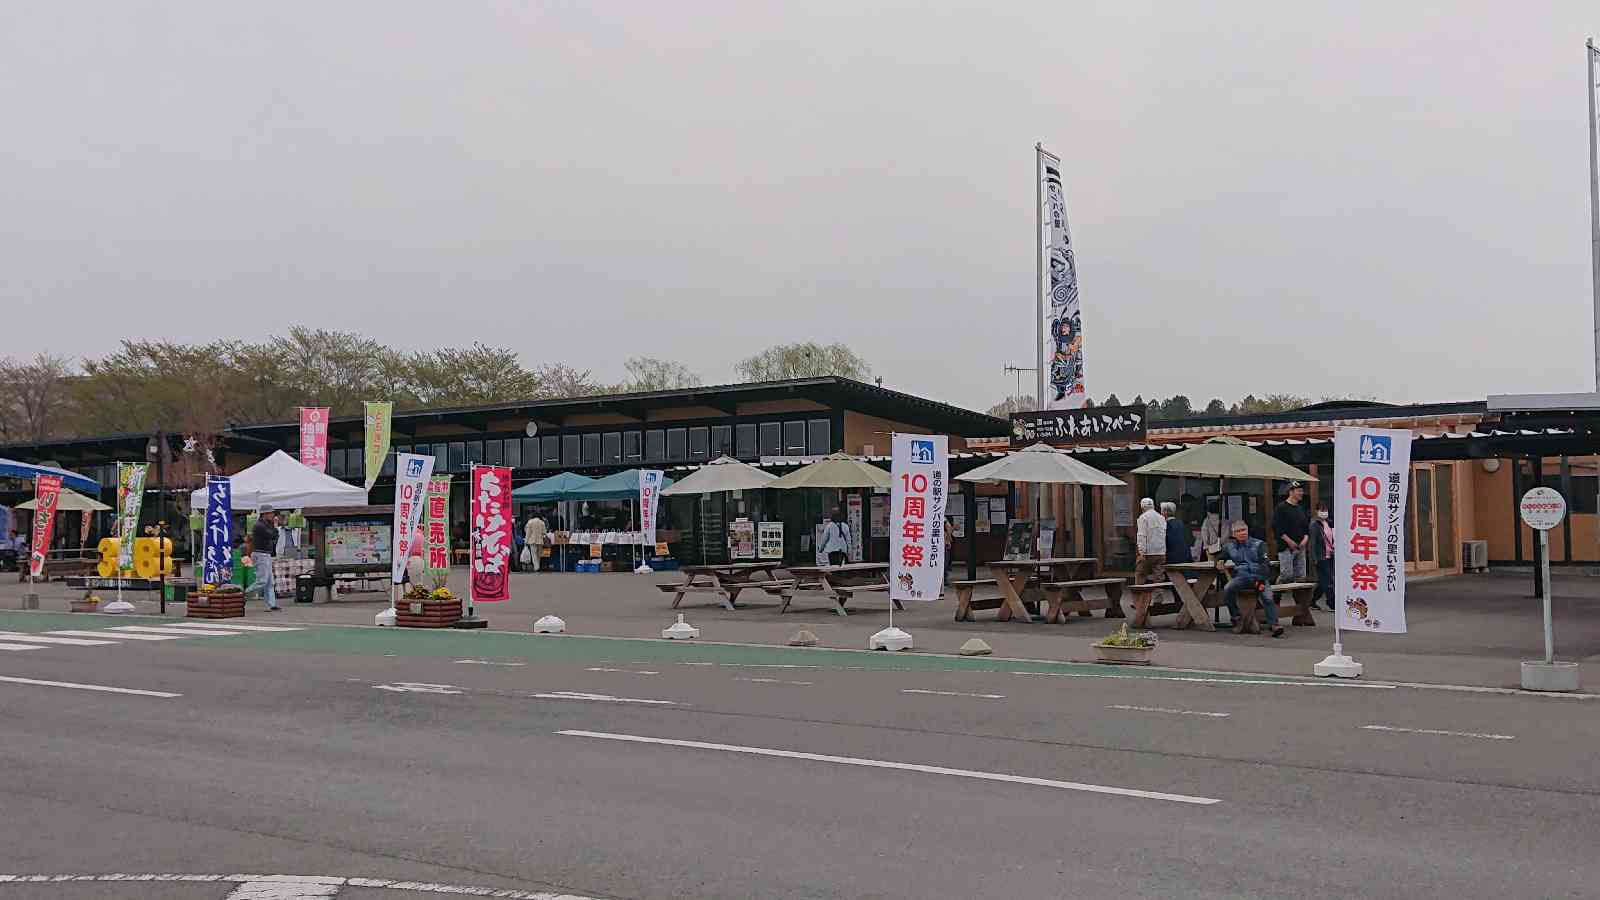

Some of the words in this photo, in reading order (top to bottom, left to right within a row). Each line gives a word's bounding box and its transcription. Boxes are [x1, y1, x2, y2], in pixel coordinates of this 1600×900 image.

[1055, 413, 1142, 438] ふれあいスペース
[429, 496, 447, 569] 直売所
[900, 473, 928, 568] 10周年祭
[929, 470, 942, 568] 道の駅サシバの里いちかい
[1346, 475, 1381, 591] 10周年祭
[1386, 472, 1400, 593] 道の駅サシバの里いちかい
